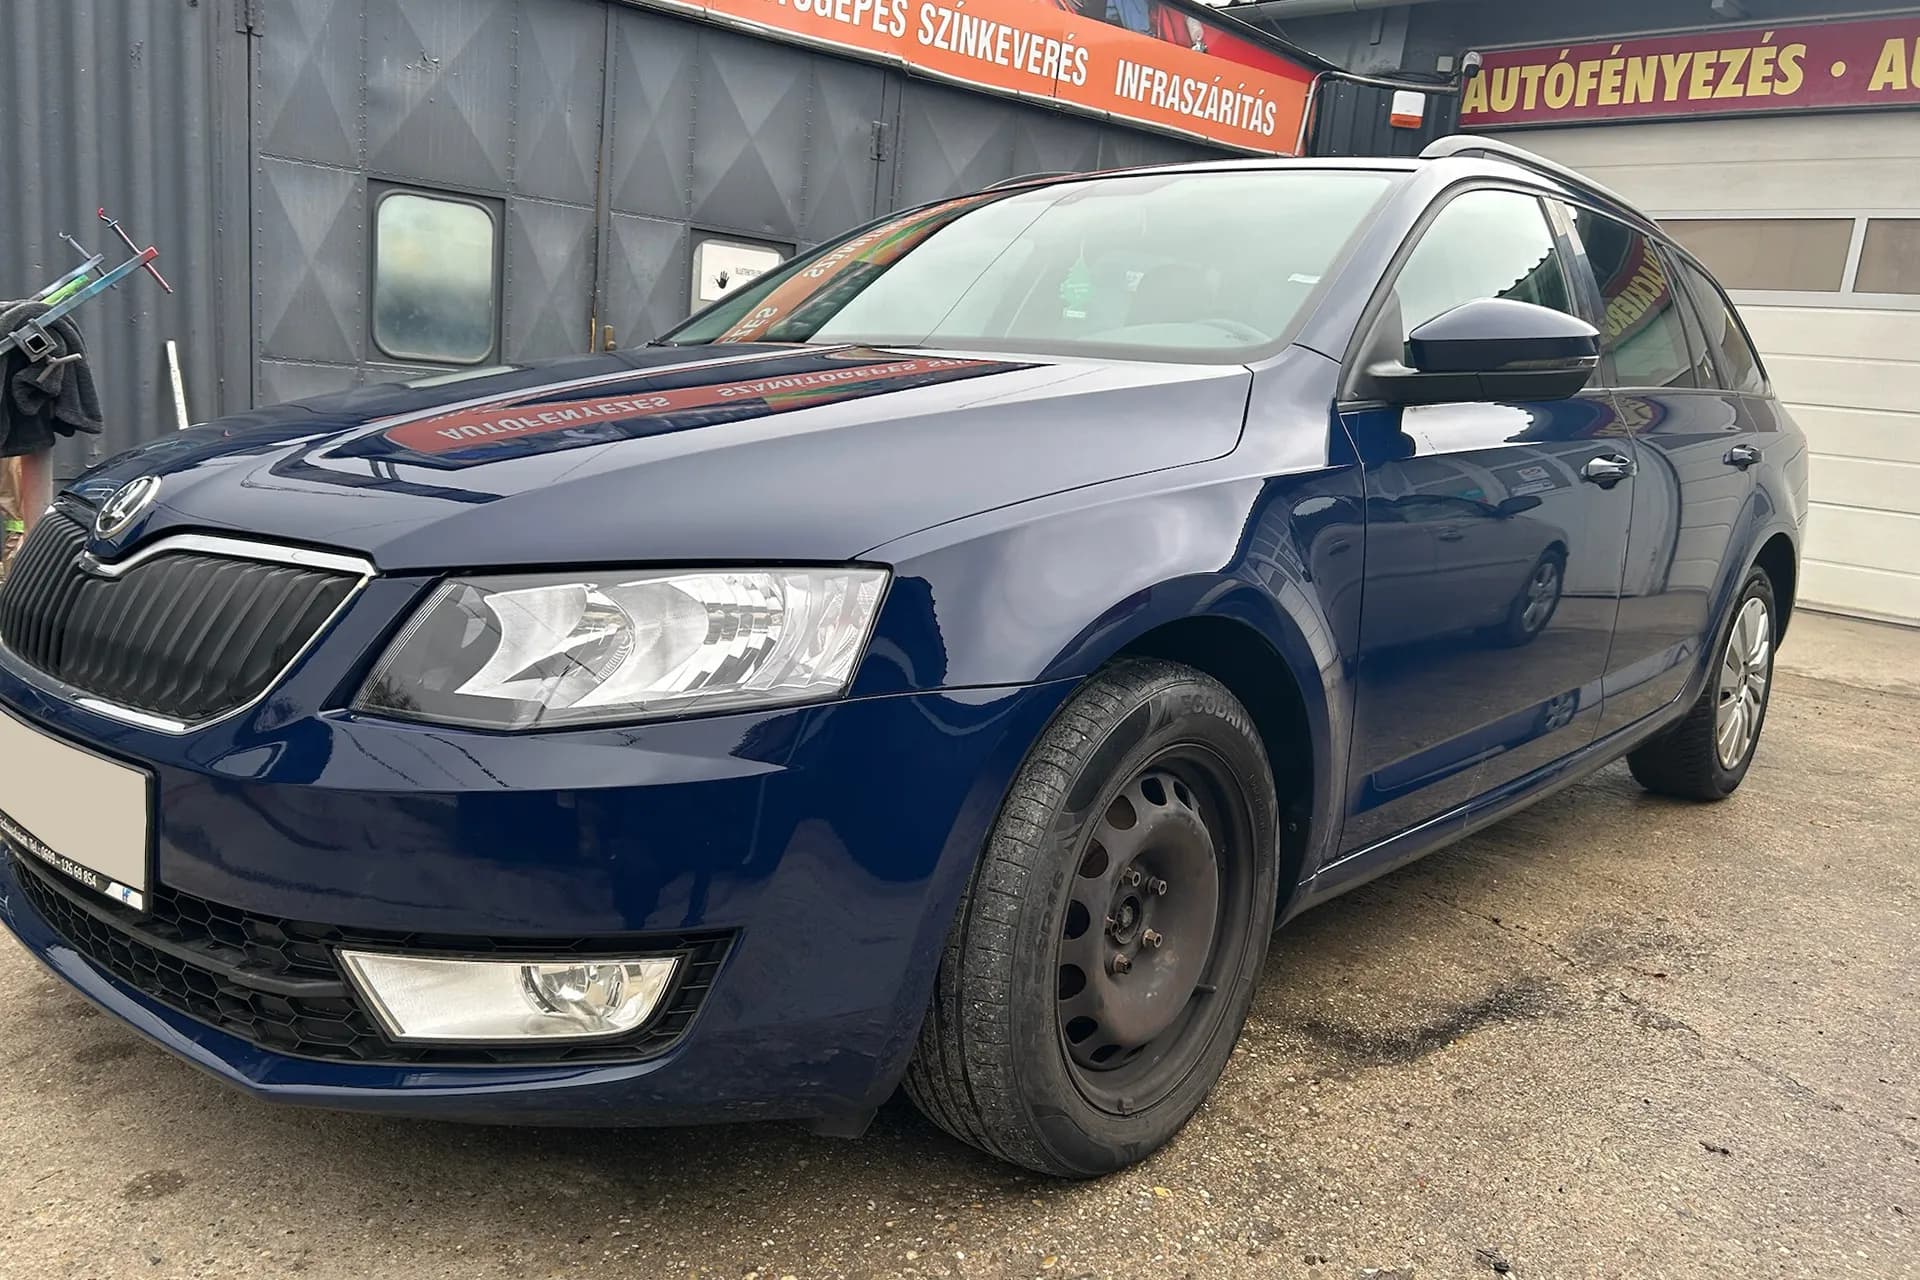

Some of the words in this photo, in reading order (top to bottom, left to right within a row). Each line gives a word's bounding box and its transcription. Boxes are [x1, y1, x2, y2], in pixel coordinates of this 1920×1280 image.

[917, 0, 1089, 86] SZÍNKEVERÉS
[1114, 59, 1277, 136] INFRASZÁRÍTÁS
[1460, 31, 1807, 114] AUTÓFÉNYEZÉS
